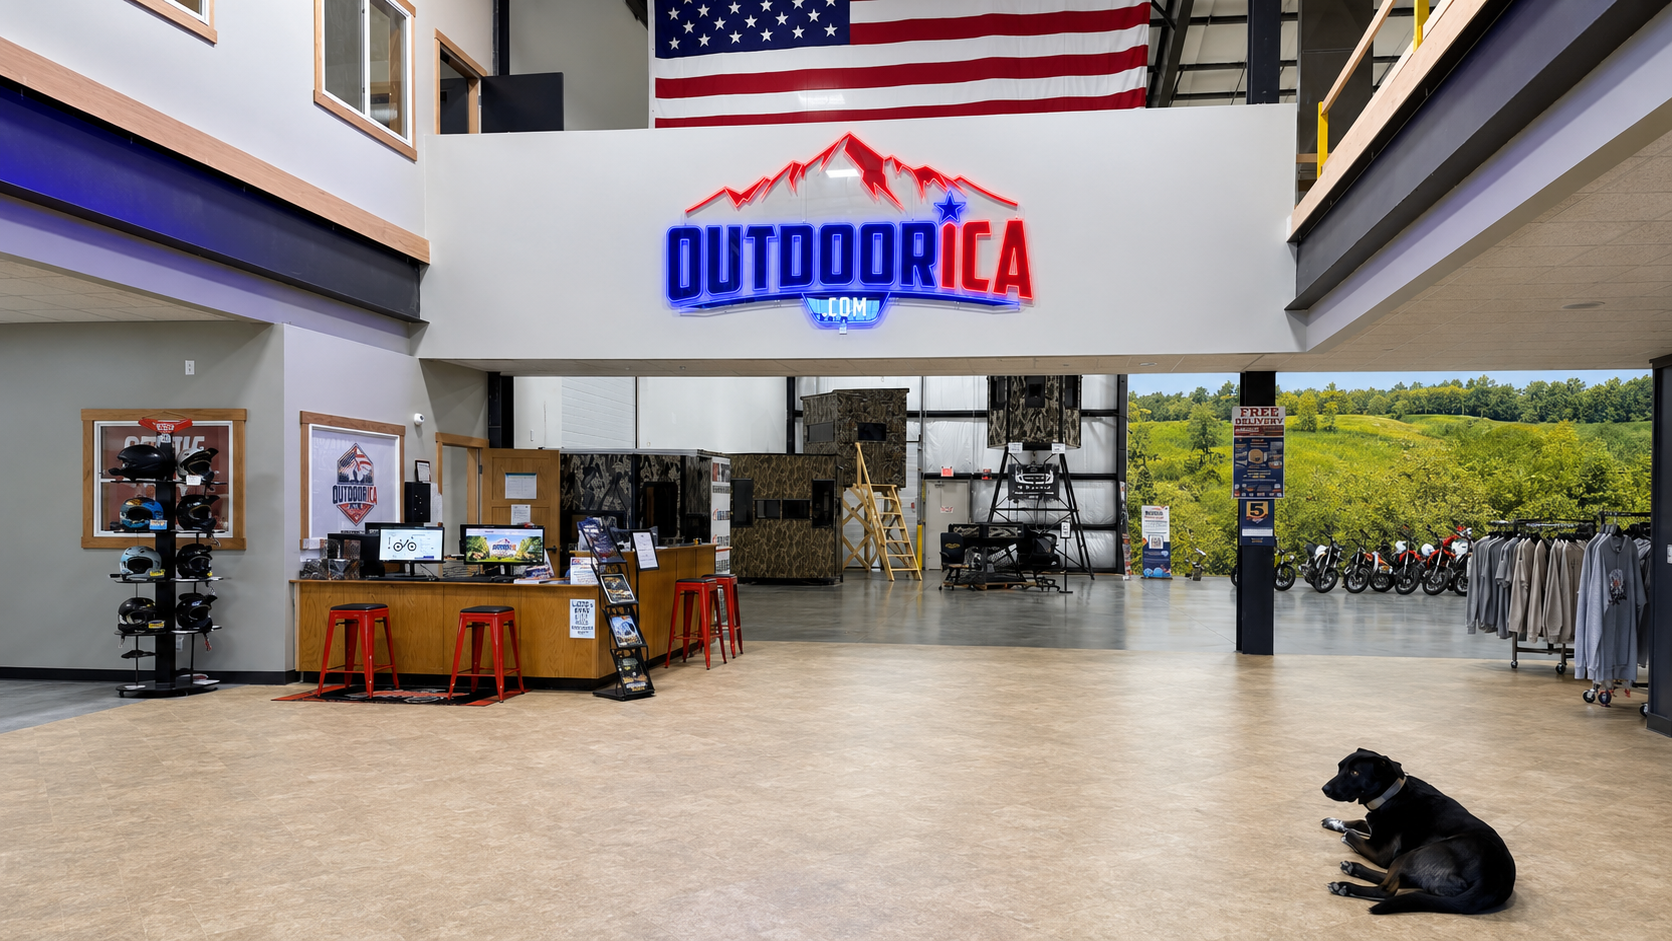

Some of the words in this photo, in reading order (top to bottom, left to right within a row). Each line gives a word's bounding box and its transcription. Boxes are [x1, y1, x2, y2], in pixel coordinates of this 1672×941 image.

[666, 218, 1034, 302] OUTDOORICA
[821, 296, 867, 318] .COM
[1240, 407, 1279, 417] FREE
[1235, 417, 1284, 425] DELIVERY
[332, 485, 378, 505] OUTDOORICA
[1249, 502, 1265, 517] 5
